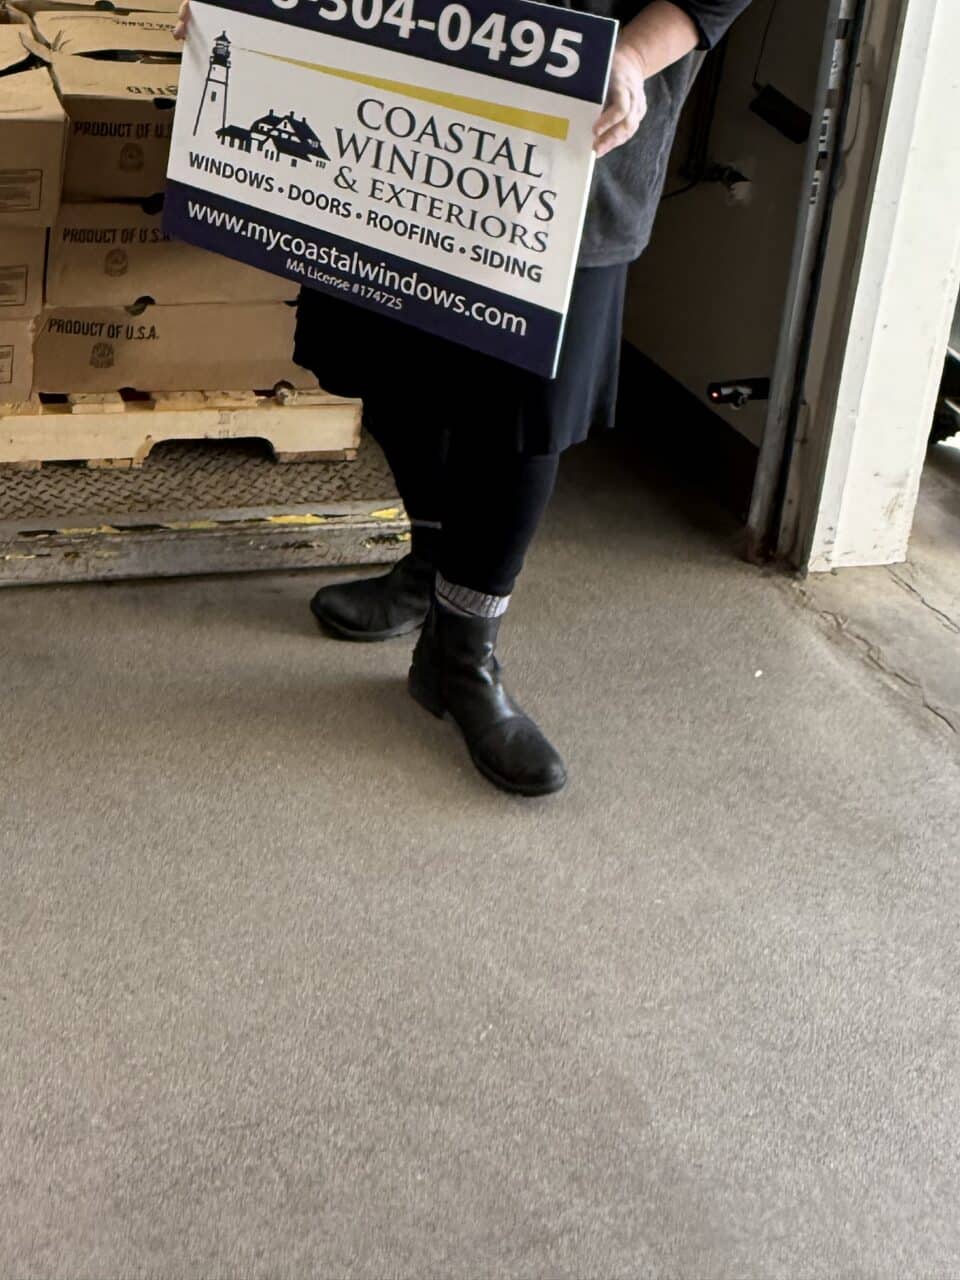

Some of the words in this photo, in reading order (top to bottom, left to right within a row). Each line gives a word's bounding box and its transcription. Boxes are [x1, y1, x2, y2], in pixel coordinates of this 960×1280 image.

[74, 121, 133, 137] PRODUCT
[136, 123, 152, 138] OF
[357, 98, 543, 178] COASTAL
[334, 165, 359, 193] &
[368, 179, 549, 253] EXTERIORS
[335, 127, 558, 222] WINDOWS
[63, 227, 117, 244] PRODUCT
[121, 228, 137, 243] OF
[189, 151, 275, 193] WINDOWS
[288, 183, 352, 219] DOORS
[366, 210, 455, 254] ROOFING
[470, 245, 543, 283] SIDING
[188, 200, 527, 337] www.mycoastalwindows.com
[286, 258, 305, 275] MA
[307, 265, 350, 291] License
[48, 319, 105, 337] PRODUCT
[107, 324, 123, 339] OF
